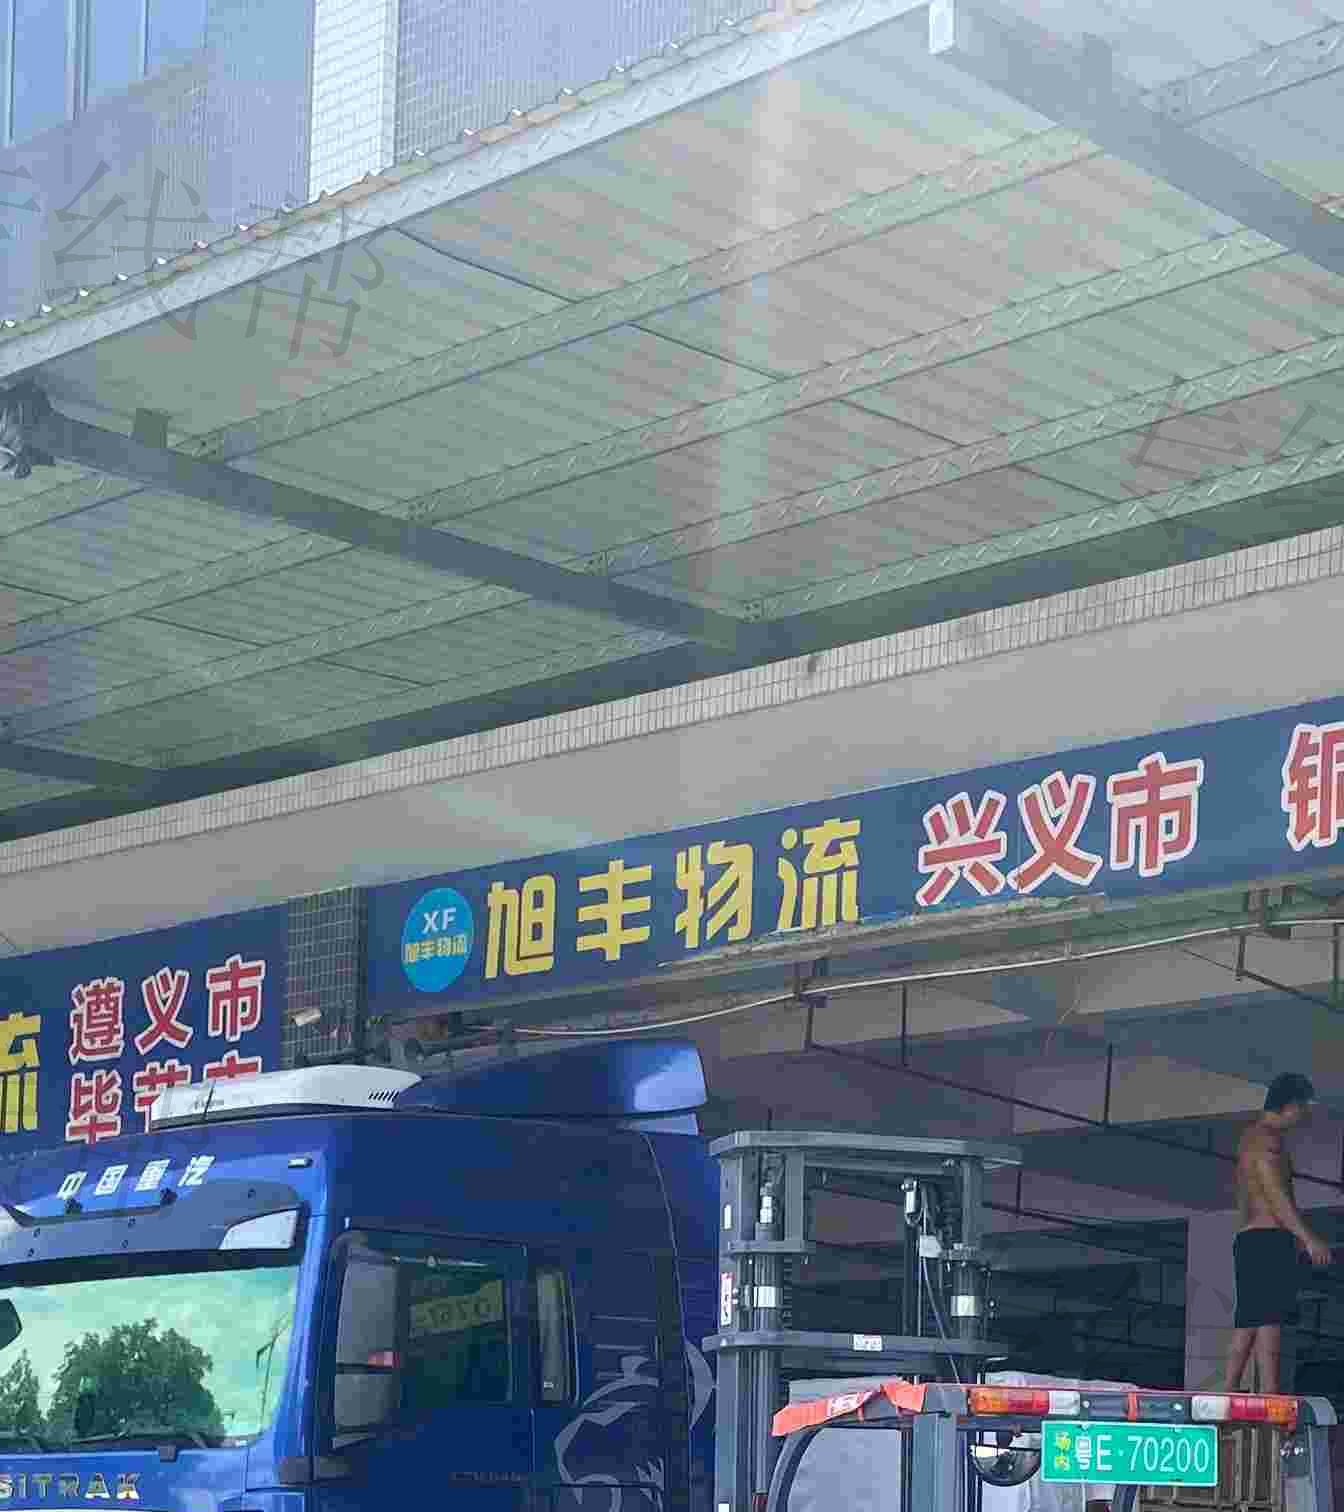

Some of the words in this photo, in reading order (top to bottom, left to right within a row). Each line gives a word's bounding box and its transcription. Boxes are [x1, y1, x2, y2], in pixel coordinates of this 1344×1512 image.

[915, 752, 1206, 907] 兴义市
[423, 906, 458, 935] XF
[485, 816, 864, 980] 旭丰物流
[68, 953, 266, 1065] 遵义市
[57, 1155, 216, 1201] 中国重汽
